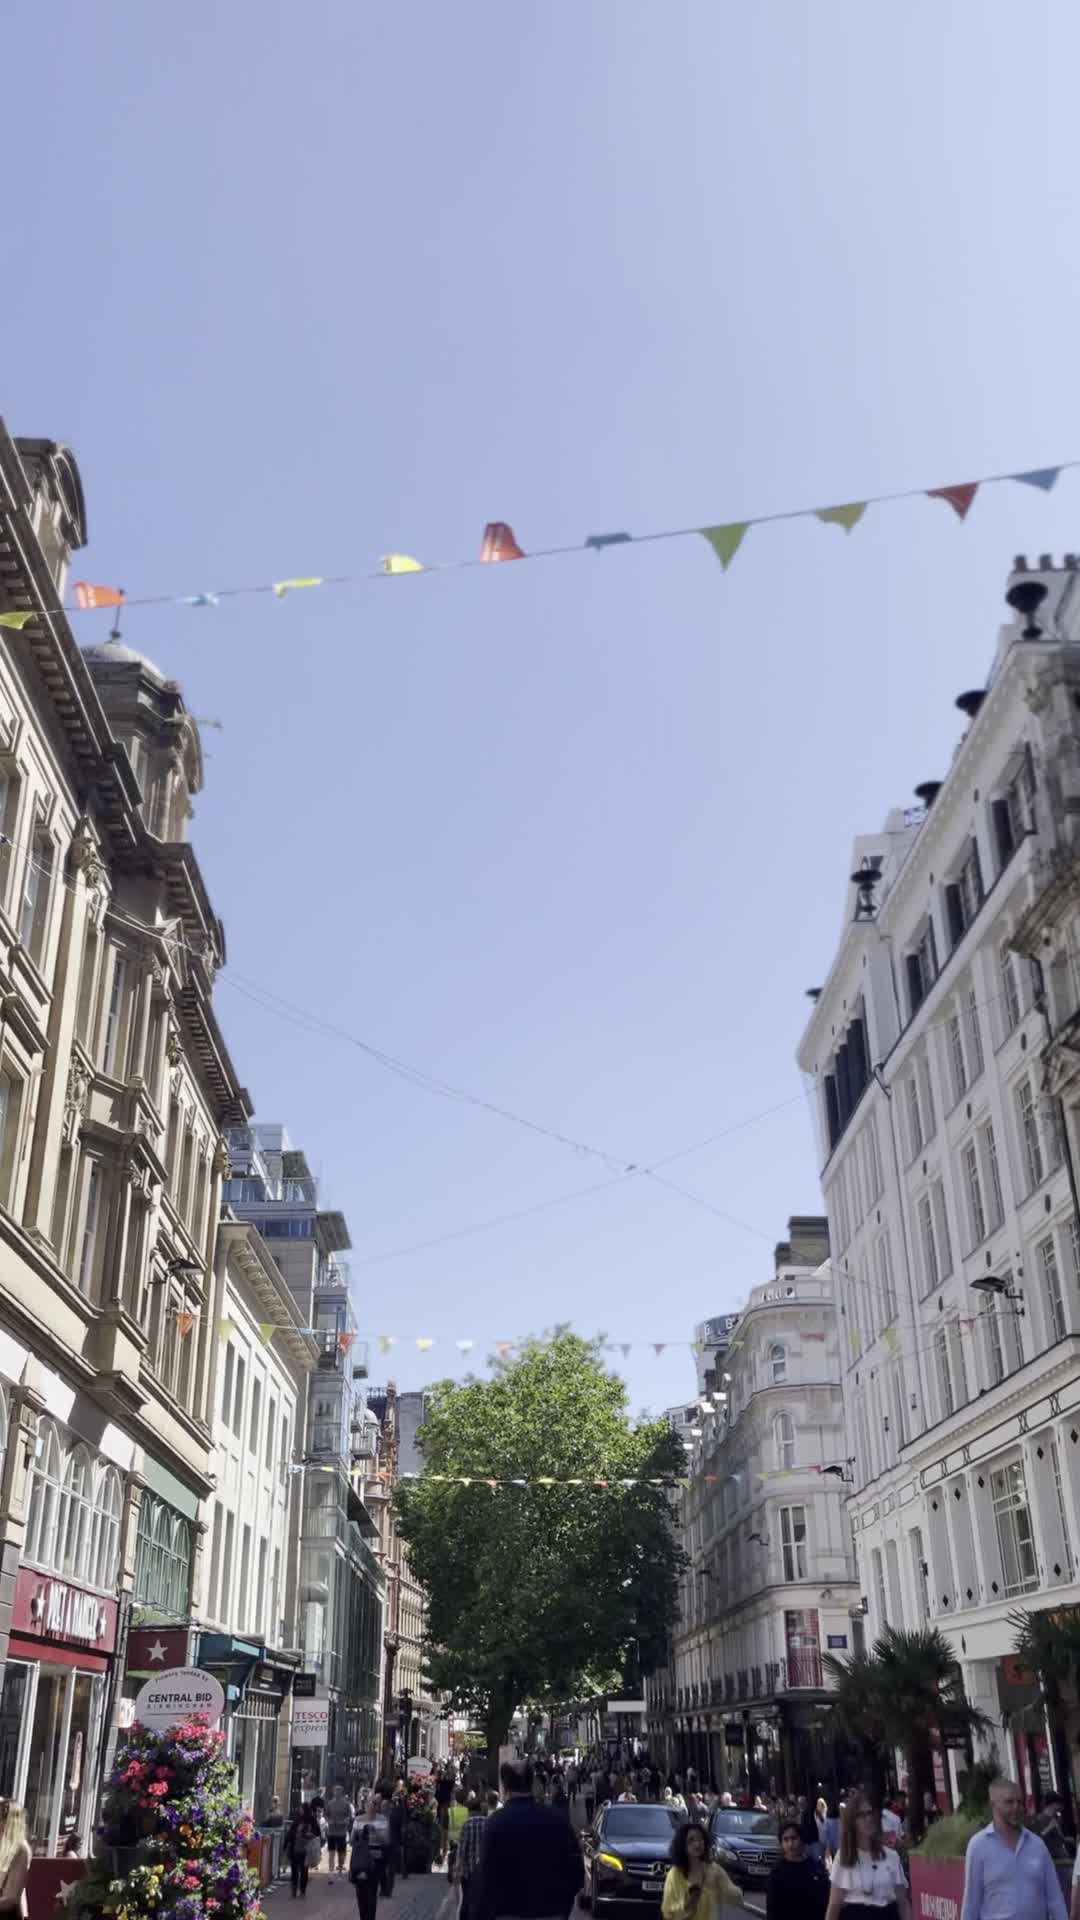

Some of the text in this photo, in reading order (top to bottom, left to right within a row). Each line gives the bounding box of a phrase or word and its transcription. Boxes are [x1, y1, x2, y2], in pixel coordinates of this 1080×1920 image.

[148, 1692, 213, 1703] CENTRAL BID
[295, 1711, 328, 1719] TESCO
